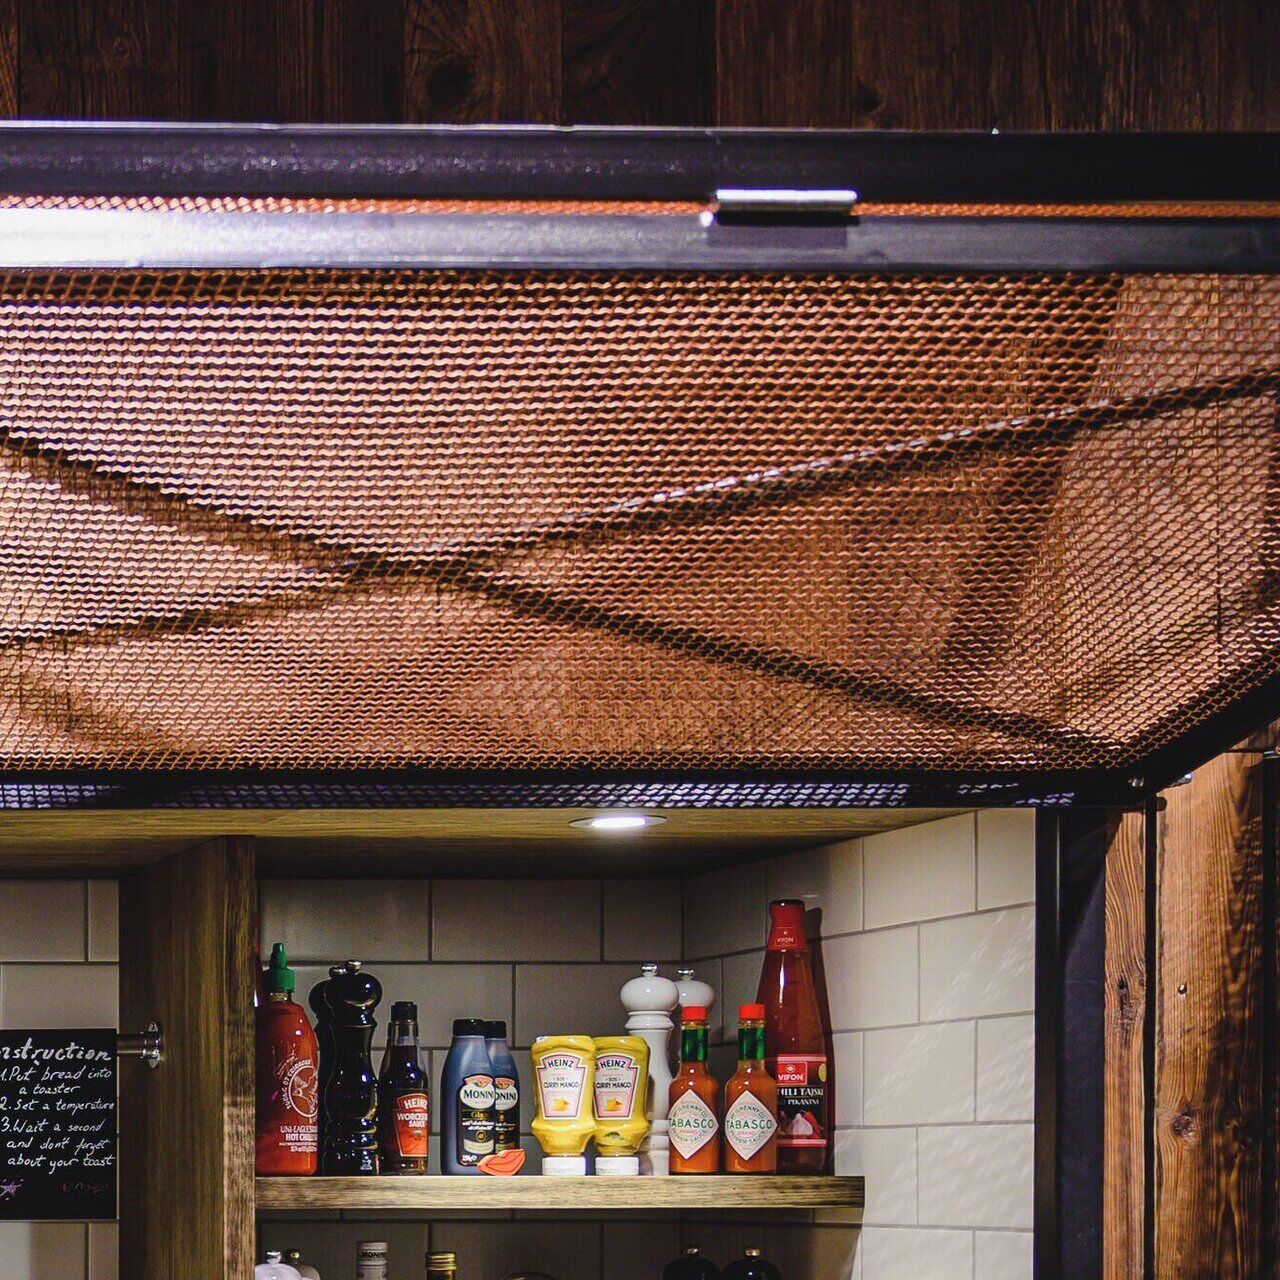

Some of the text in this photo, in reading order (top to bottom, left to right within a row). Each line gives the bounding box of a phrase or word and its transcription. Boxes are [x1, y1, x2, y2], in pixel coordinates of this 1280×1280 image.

[547, 1058, 575, 1068] HEINZ
[599, 1059, 627, 1069] HEINZ
[41, 1065, 87, 1082] bread
[88, 1067, 112, 1080] into
[19, 1083, 81, 1095] a toaster
[42, 1103, 50, 1111] a
[56, 1098, 115, 1116] temperature
[53, 1123, 62, 1132] a
[67, 1118, 107, 1132] second
[669, 1118, 715, 1129] TABASCO
[726, 1119, 773, 1130] TABASCO
[6, 1136, 34, 1149] and
[74, 1139, 110, 1156] forget
[8, 1153, 116, 1175] about your toast
